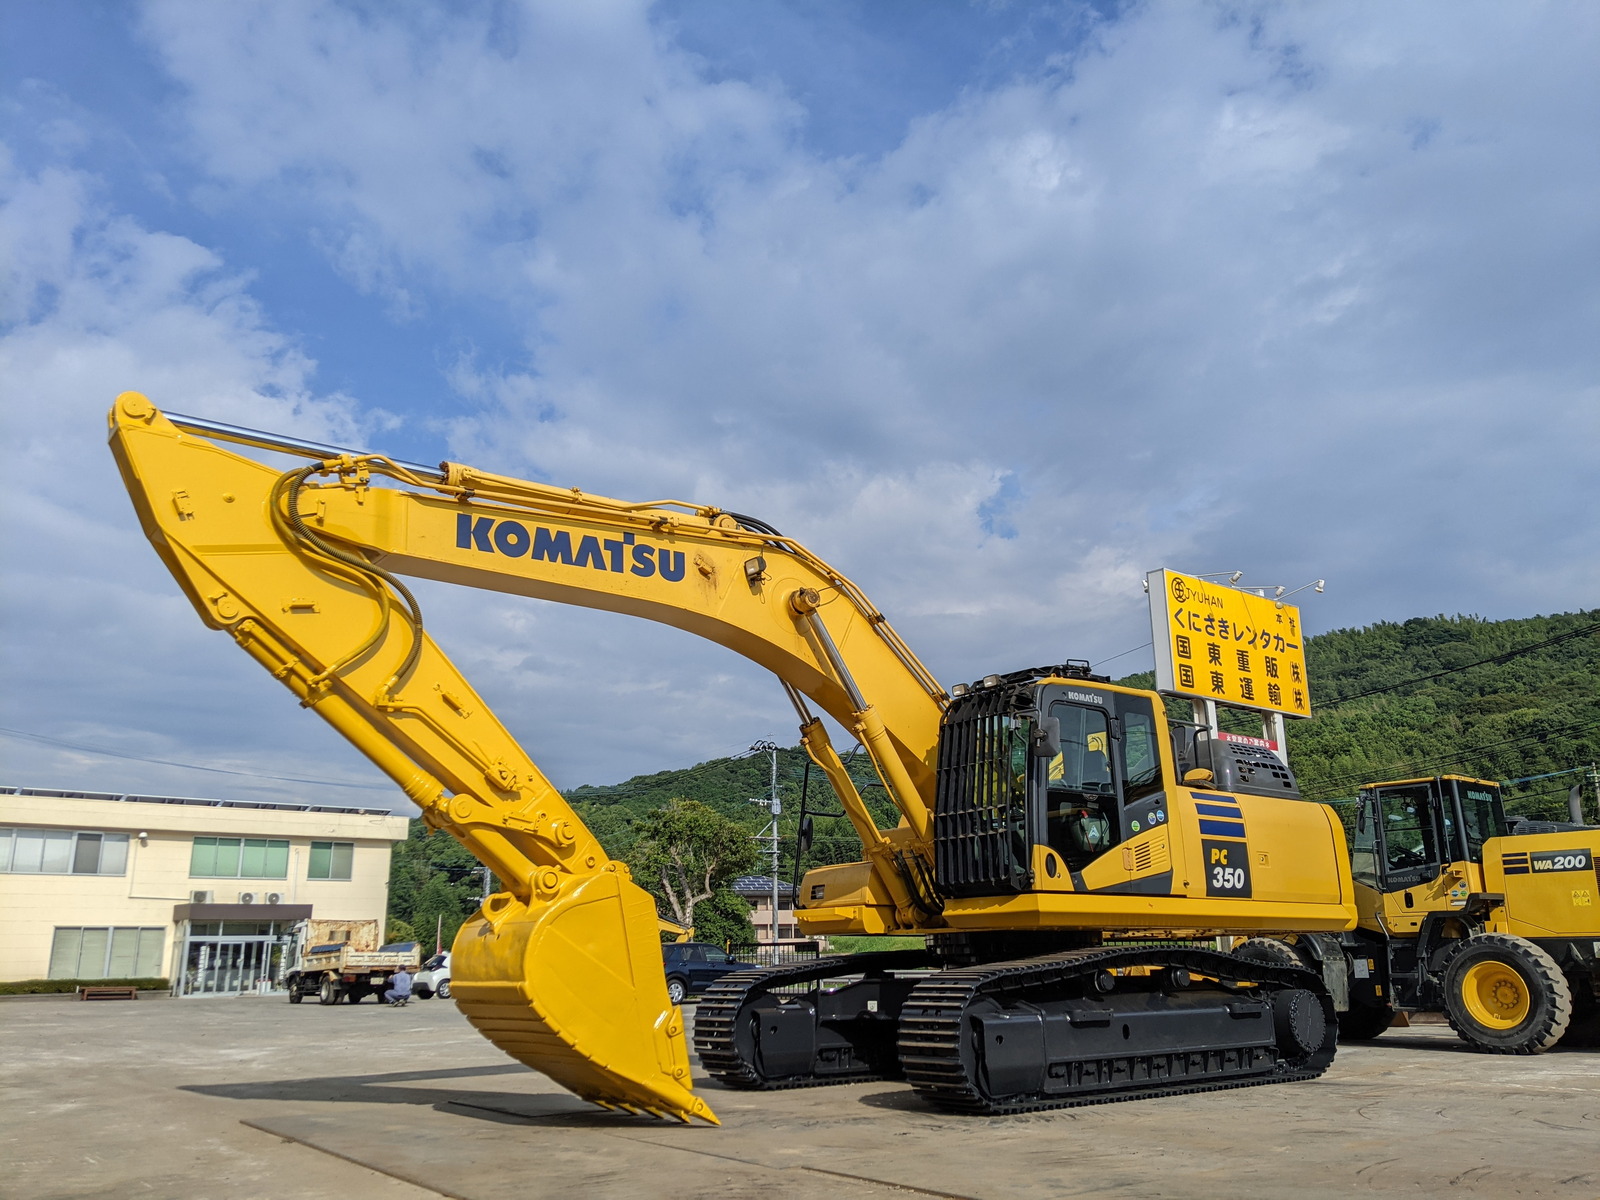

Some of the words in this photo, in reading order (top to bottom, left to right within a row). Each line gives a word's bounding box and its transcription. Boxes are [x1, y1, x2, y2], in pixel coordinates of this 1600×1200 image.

[456, 513, 685, 582] KOMATSU
[1185, 587, 1224, 609] JYUHAN
[1174, 607, 1299, 653] くにさきレンタカー
[1068, 691, 1103, 704] KOMATSU
[1467, 790, 1493, 802] KOMATSU
[1211, 848, 1228, 865] PC
[1533, 855, 1587, 871] WA200
[1212, 866, 1245, 889] 350
